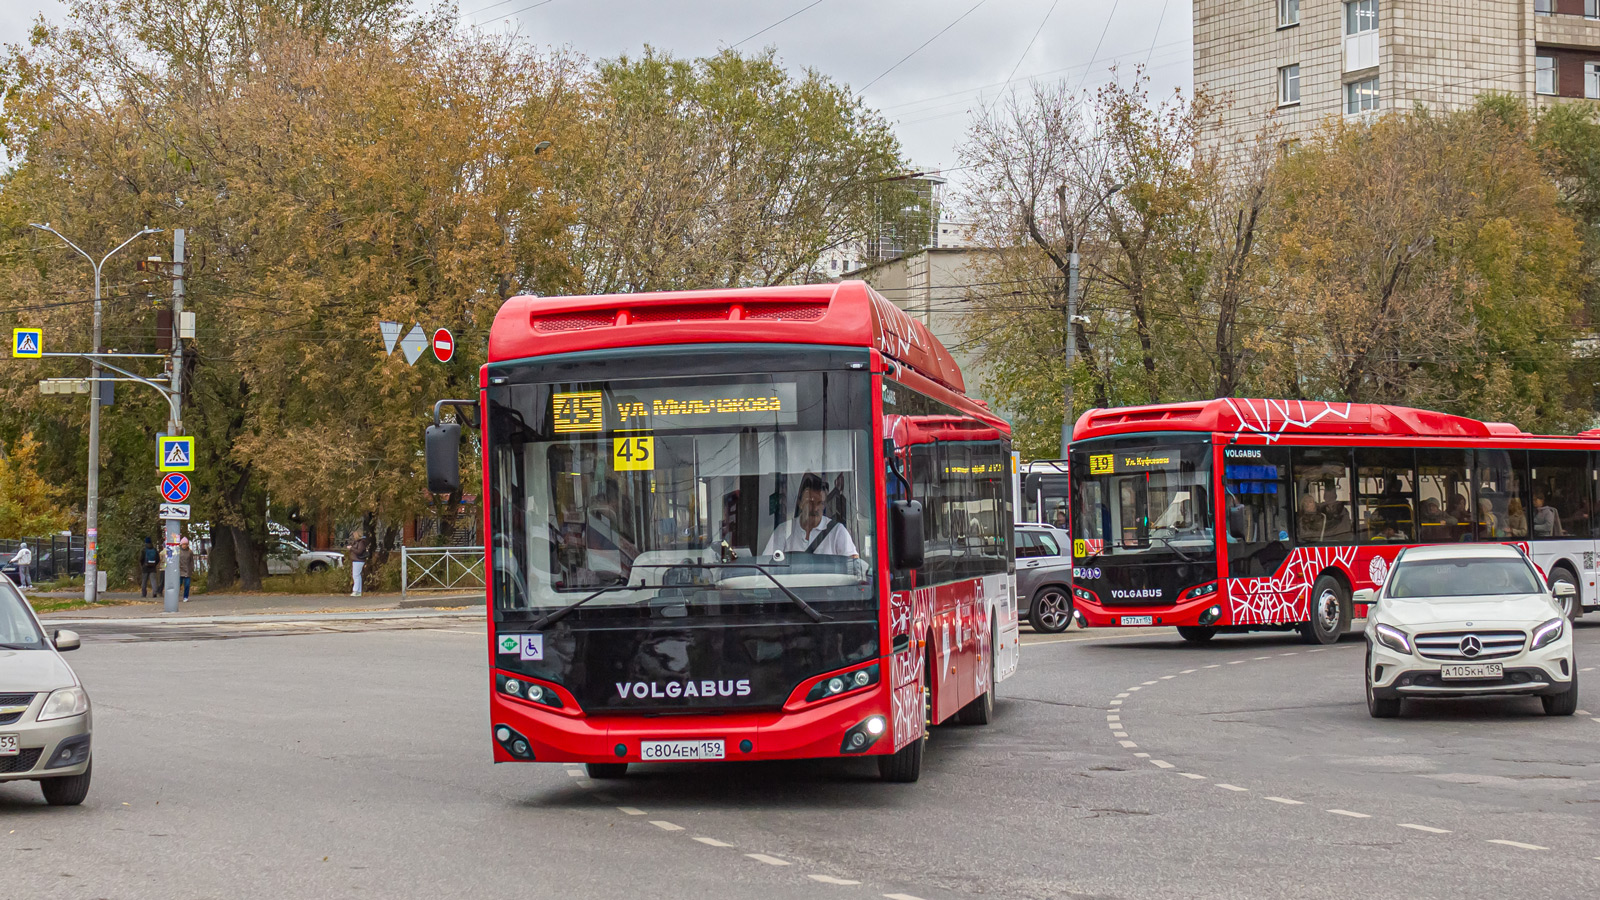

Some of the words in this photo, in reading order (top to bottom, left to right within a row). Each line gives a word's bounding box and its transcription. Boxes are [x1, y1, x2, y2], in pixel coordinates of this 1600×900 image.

[557, 396, 596, 427] 45
[616, 438, 650, 462] 45
[1225, 449, 1262, 458] VOLGABUS
[1075, 542, 1085, 555] 19
[1111, 589, 1162, 598] VOLGABUS
[615, 679, 751, 699] VOLGABUS
[646, 743, 699, 758] С804ЕМ
[701, 742, 721, 753] 159
